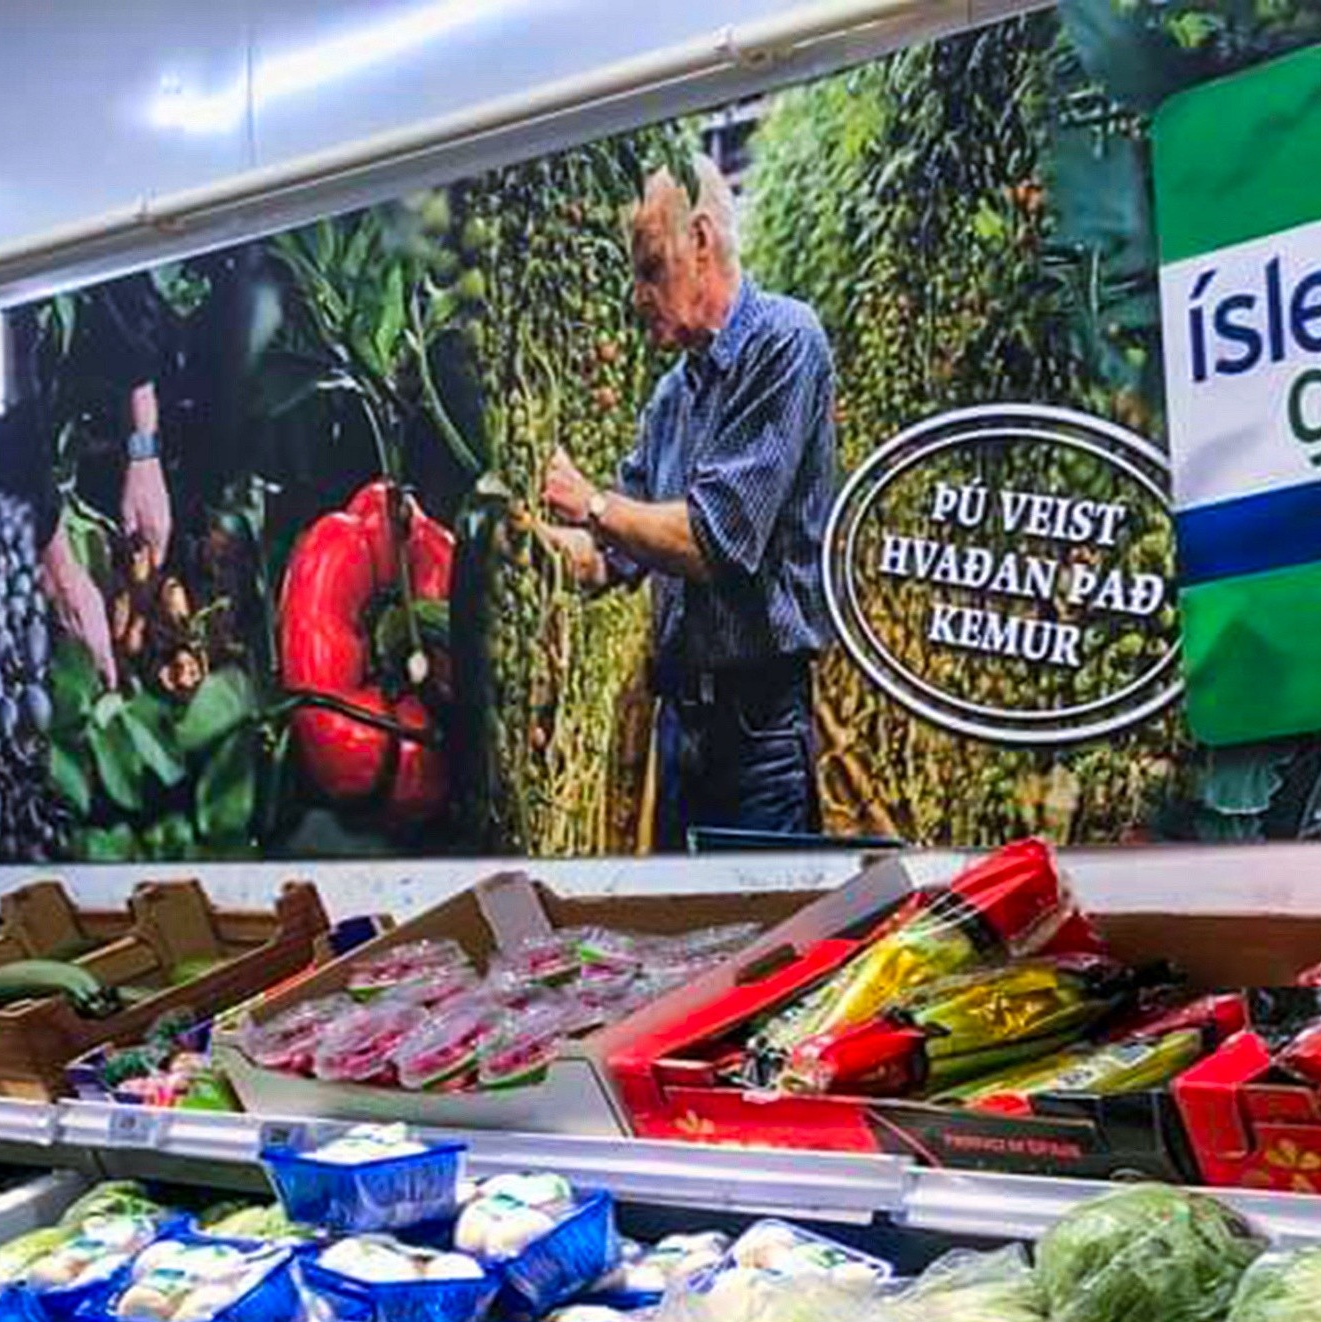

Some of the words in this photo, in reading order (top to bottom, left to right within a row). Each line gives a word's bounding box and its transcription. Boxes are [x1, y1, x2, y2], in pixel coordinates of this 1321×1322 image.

[932, 477, 987, 526] ÞÚ
[1000, 491, 1126, 545] VEIST
[879, 535, 1059, 598] HVAÐAN
[1067, 563, 1165, 615] ÞAÐ
[929, 603, 1081, 667] KEMUR
